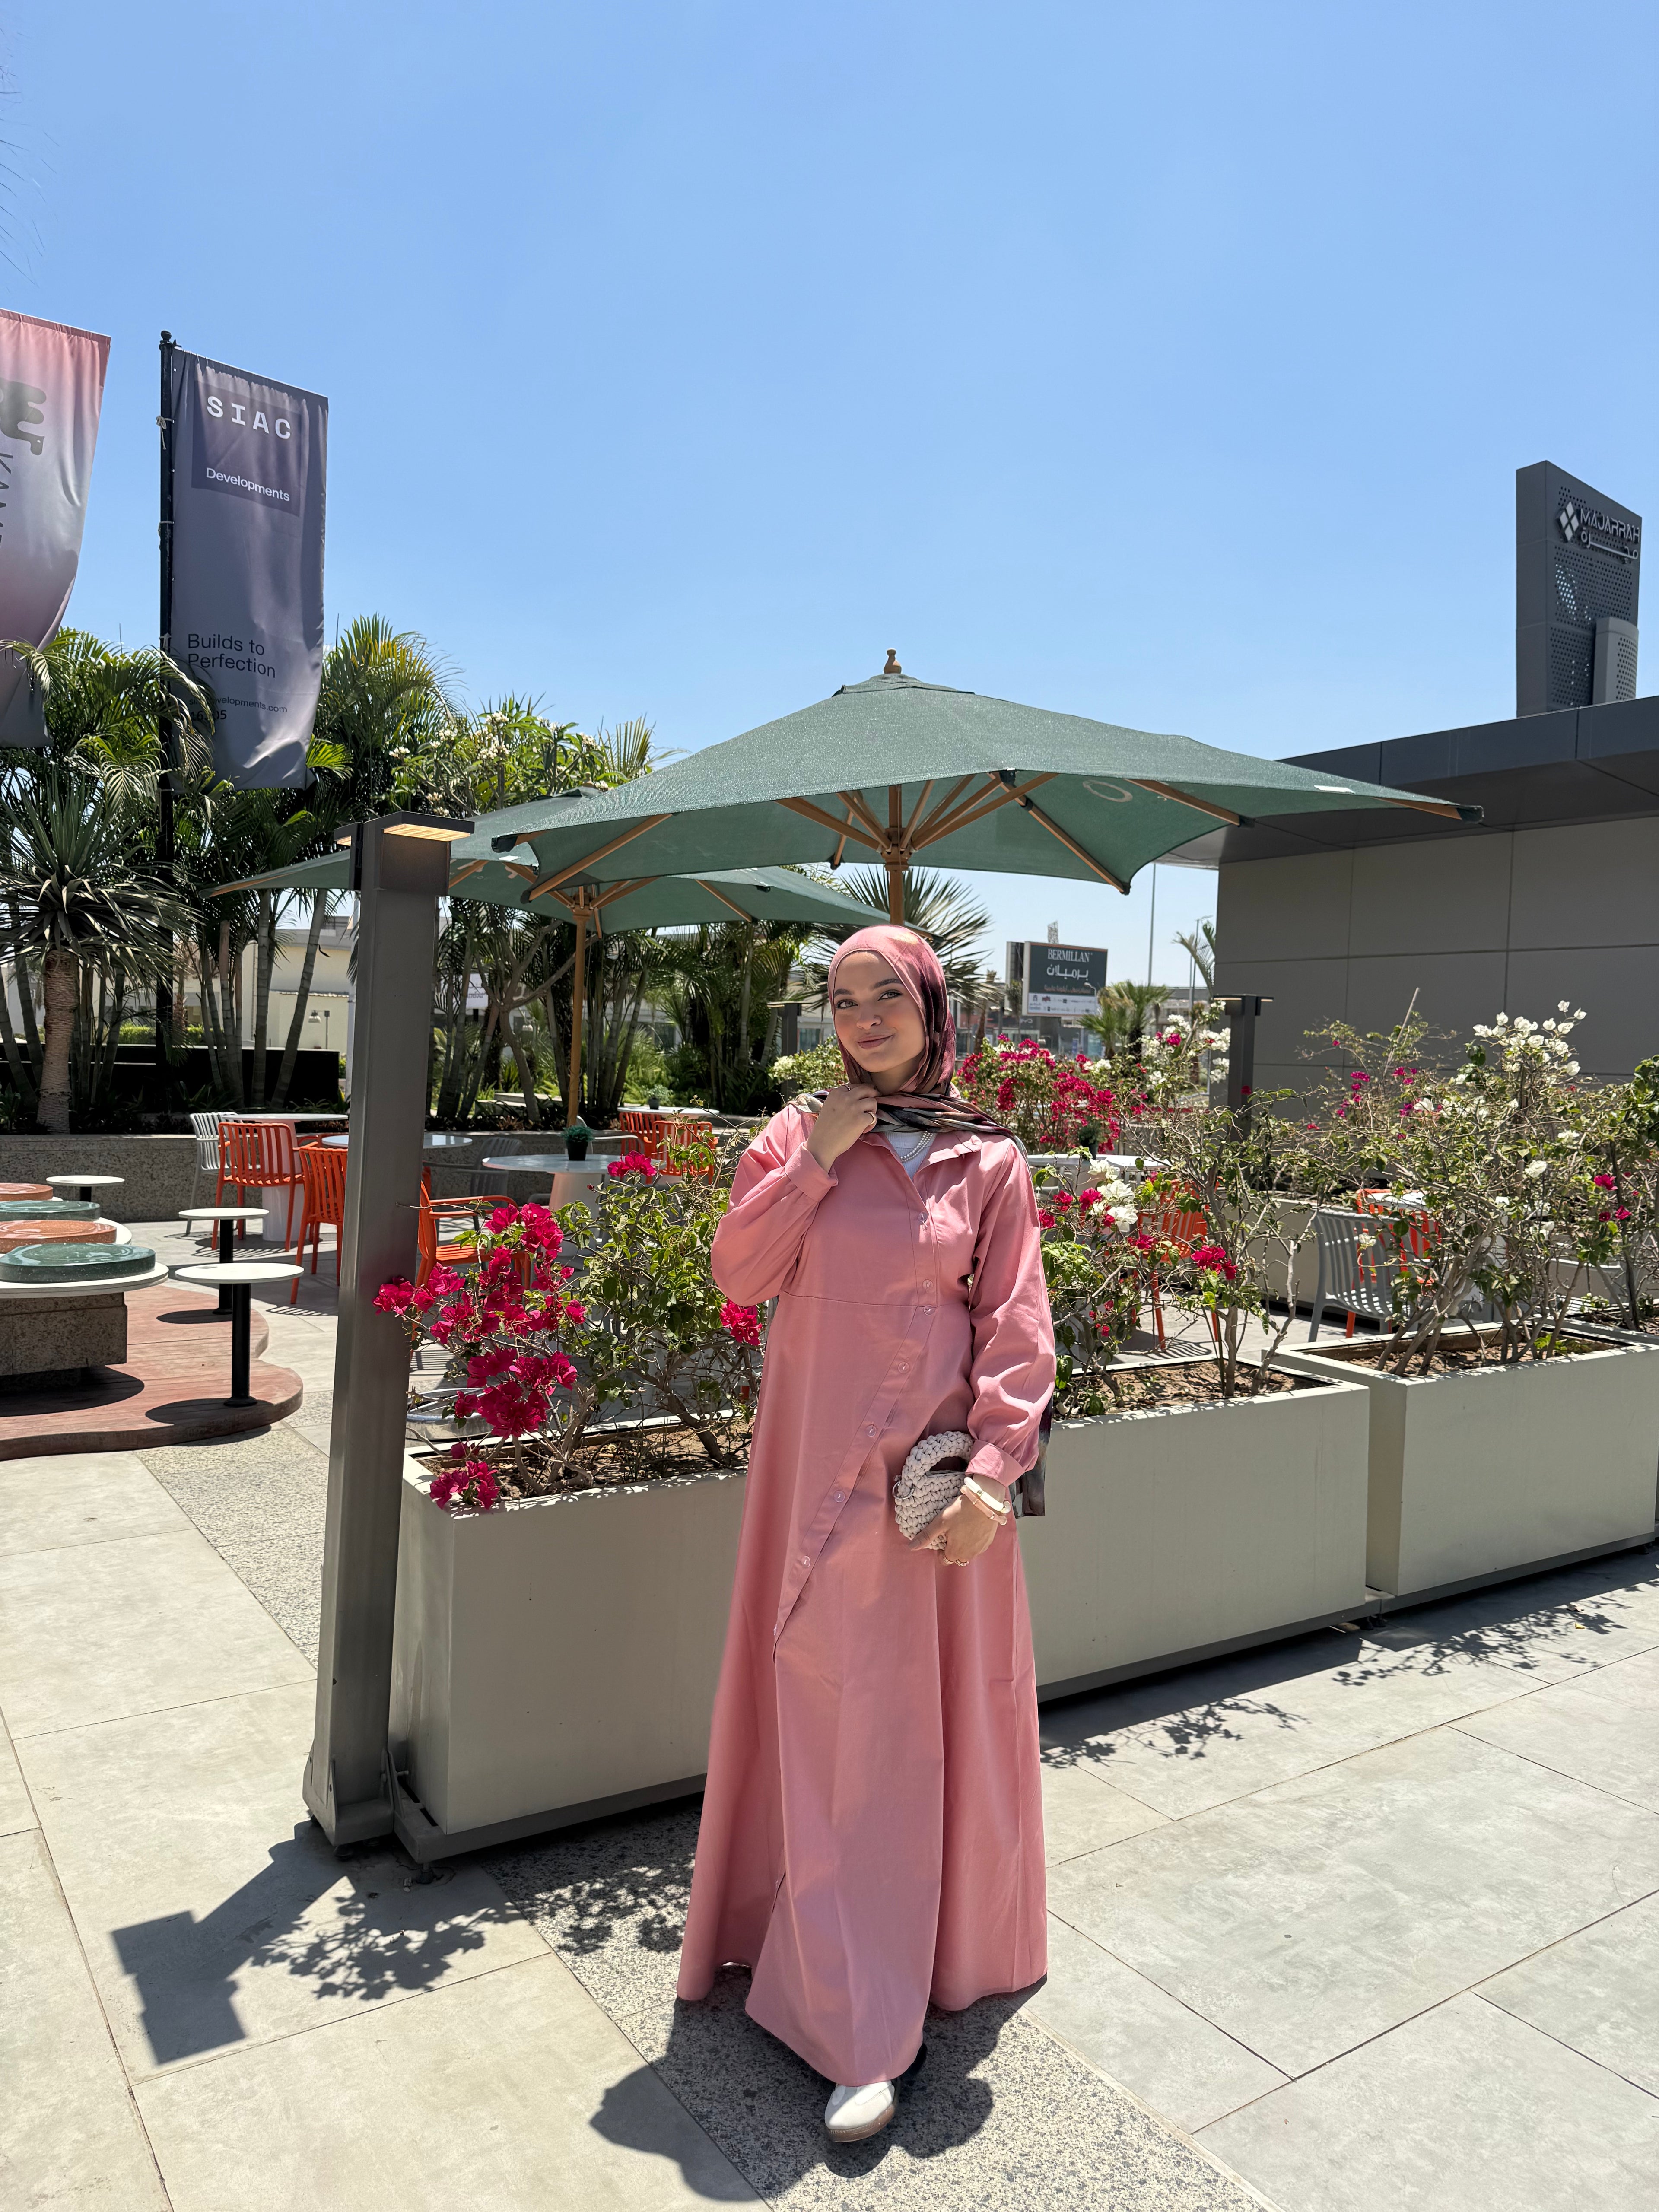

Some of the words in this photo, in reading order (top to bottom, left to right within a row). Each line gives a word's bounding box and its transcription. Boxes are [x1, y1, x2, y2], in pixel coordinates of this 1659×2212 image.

[207, 396, 291, 439] SIAC
[206, 467, 290, 502] Developments
[1580, 508, 1640, 543] MAJARRAH
[188, 633, 243, 651] Builds
[249, 639, 265, 655] to
[188, 653, 275, 678] Perfection
[1047, 949, 1090, 963] BERMILLAN
[1046, 964, 1089, 981] برميلان
